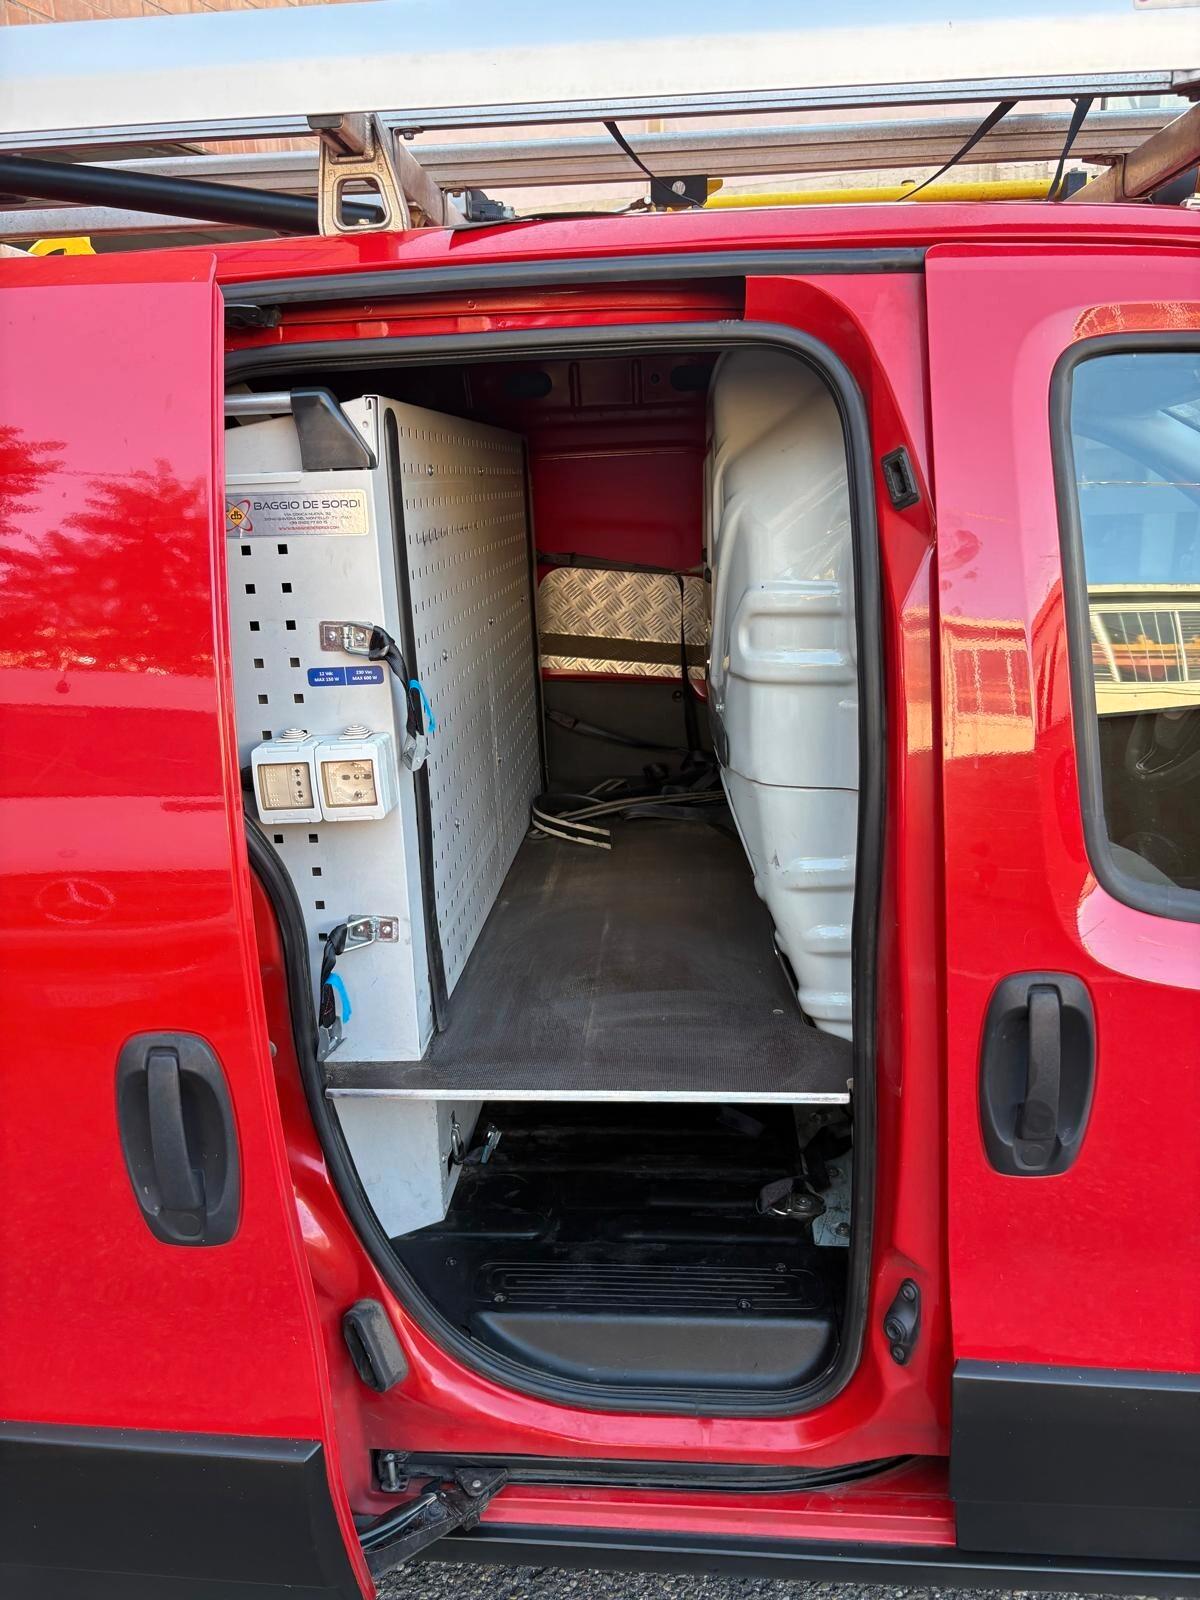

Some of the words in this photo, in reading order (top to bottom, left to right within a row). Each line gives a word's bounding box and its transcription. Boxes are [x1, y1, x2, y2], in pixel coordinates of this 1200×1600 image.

[253, 501, 300, 511] BAGGIO
[302, 500, 319, 509] DE
[321, 499, 361, 509] SORDI
